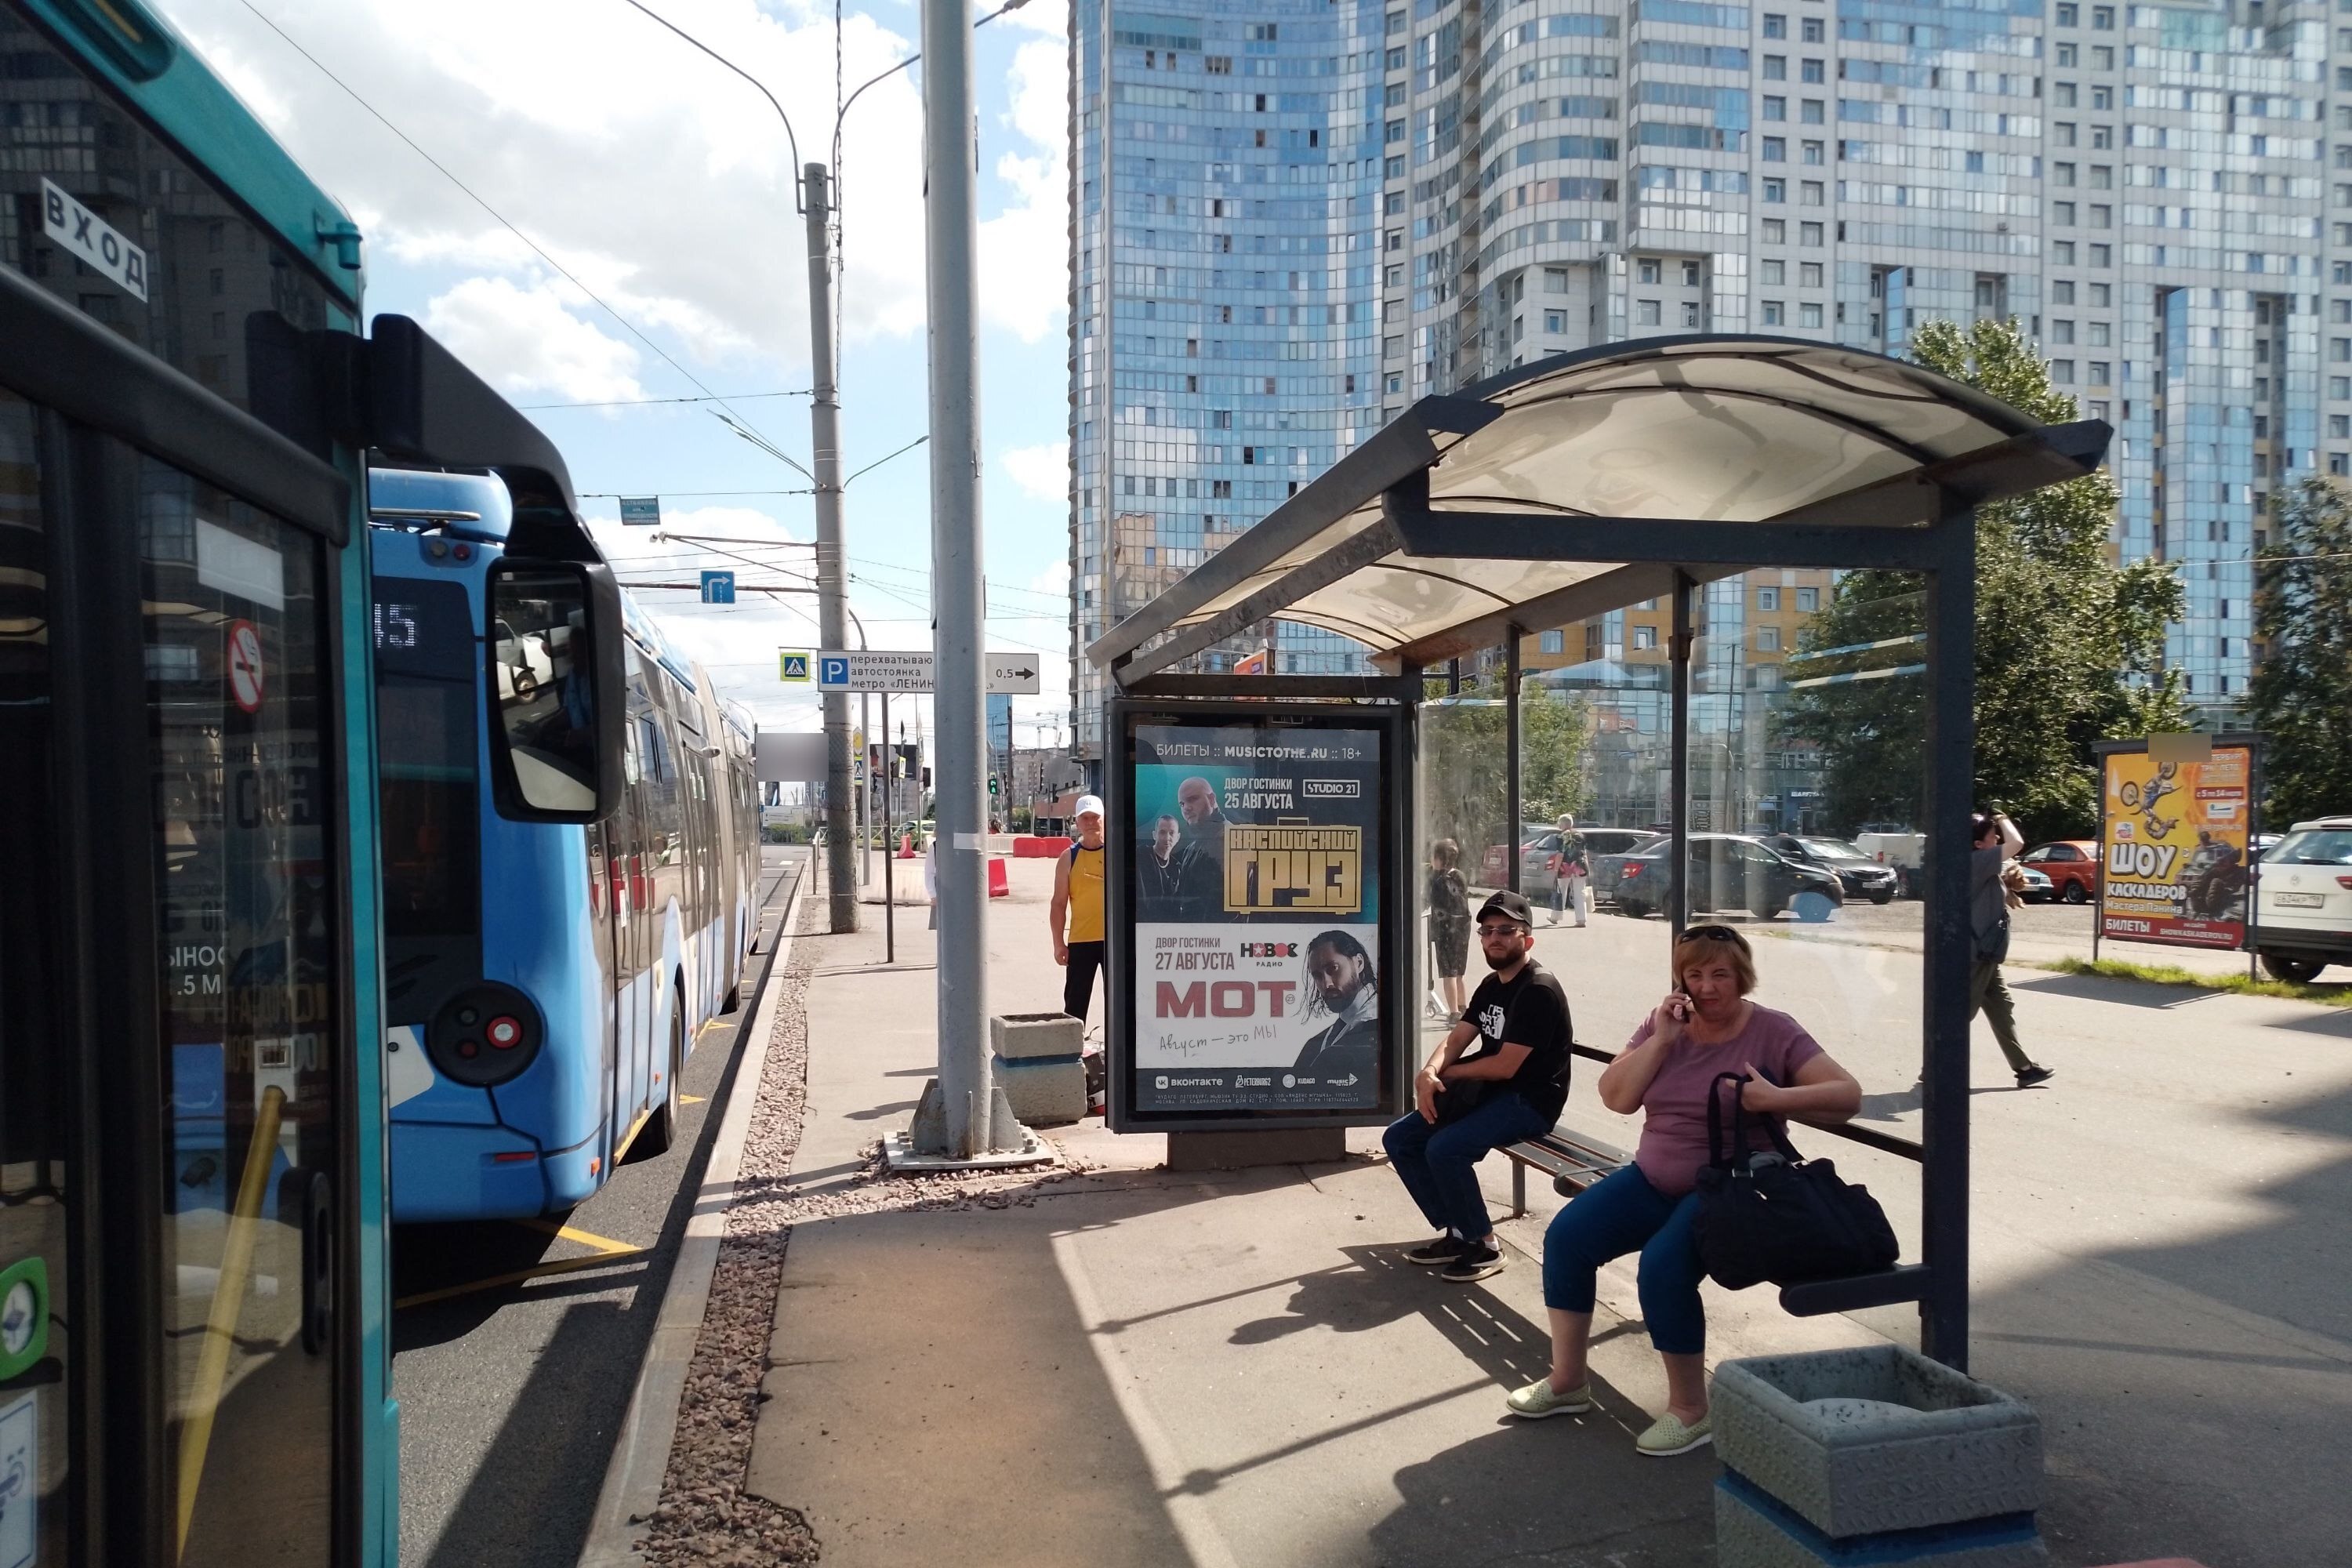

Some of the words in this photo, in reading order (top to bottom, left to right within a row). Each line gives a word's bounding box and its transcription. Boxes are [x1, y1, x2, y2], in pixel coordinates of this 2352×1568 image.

[45, 187, 146, 296] ВХОД
[851, 655, 933, 666] перехватываю
[851, 668, 921, 677] автостоянка
[851, 680, 885, 691] метро
[890, 679, 935, 689] «ЛЕНИН
[1156, 744, 1210, 757] БИЛЕТЫ
[1225, 746, 1327, 759] MUSICTOTHE.RU
[1341, 748, 1362, 760] 18+
[1224, 777, 1247, 790] ДВОР
[1248, 778, 1293, 790] ГОСТИНКИ
[1307, 782, 1344, 794] STUDIO
[1345, 784, 1356, 794] 21
[1225, 793, 1240, 809] 25
[1242, 793, 1294, 810] АВГУСТА
[1230, 829, 1356, 851] КАСПИЙСКИЙ
[2110, 843, 2176, 878] ШОУ
[1230, 851, 1356, 906] ГРУЗ
[2107, 882, 2187, 900] КАСКАДЕРОВ
[2105, 901, 2145, 913] Мастера
[2147, 903, 2183, 914] Панина
[2105, 918, 2151, 933] БИЛЕТЫ
[1156, 937, 1178, 949] ДВОР
[1179, 937, 1221, 949] ГОСТИНКИ
[1156, 953, 1172, 971] 27
[1175, 953, 1235, 971] АВГУСТА
[1156, 981, 1296, 1018] МОТ
[1160, 1036, 1207, 1058] Август
[1227, 1033, 1249, 1044] это
[1254, 1025, 1276, 1040] МЫ
